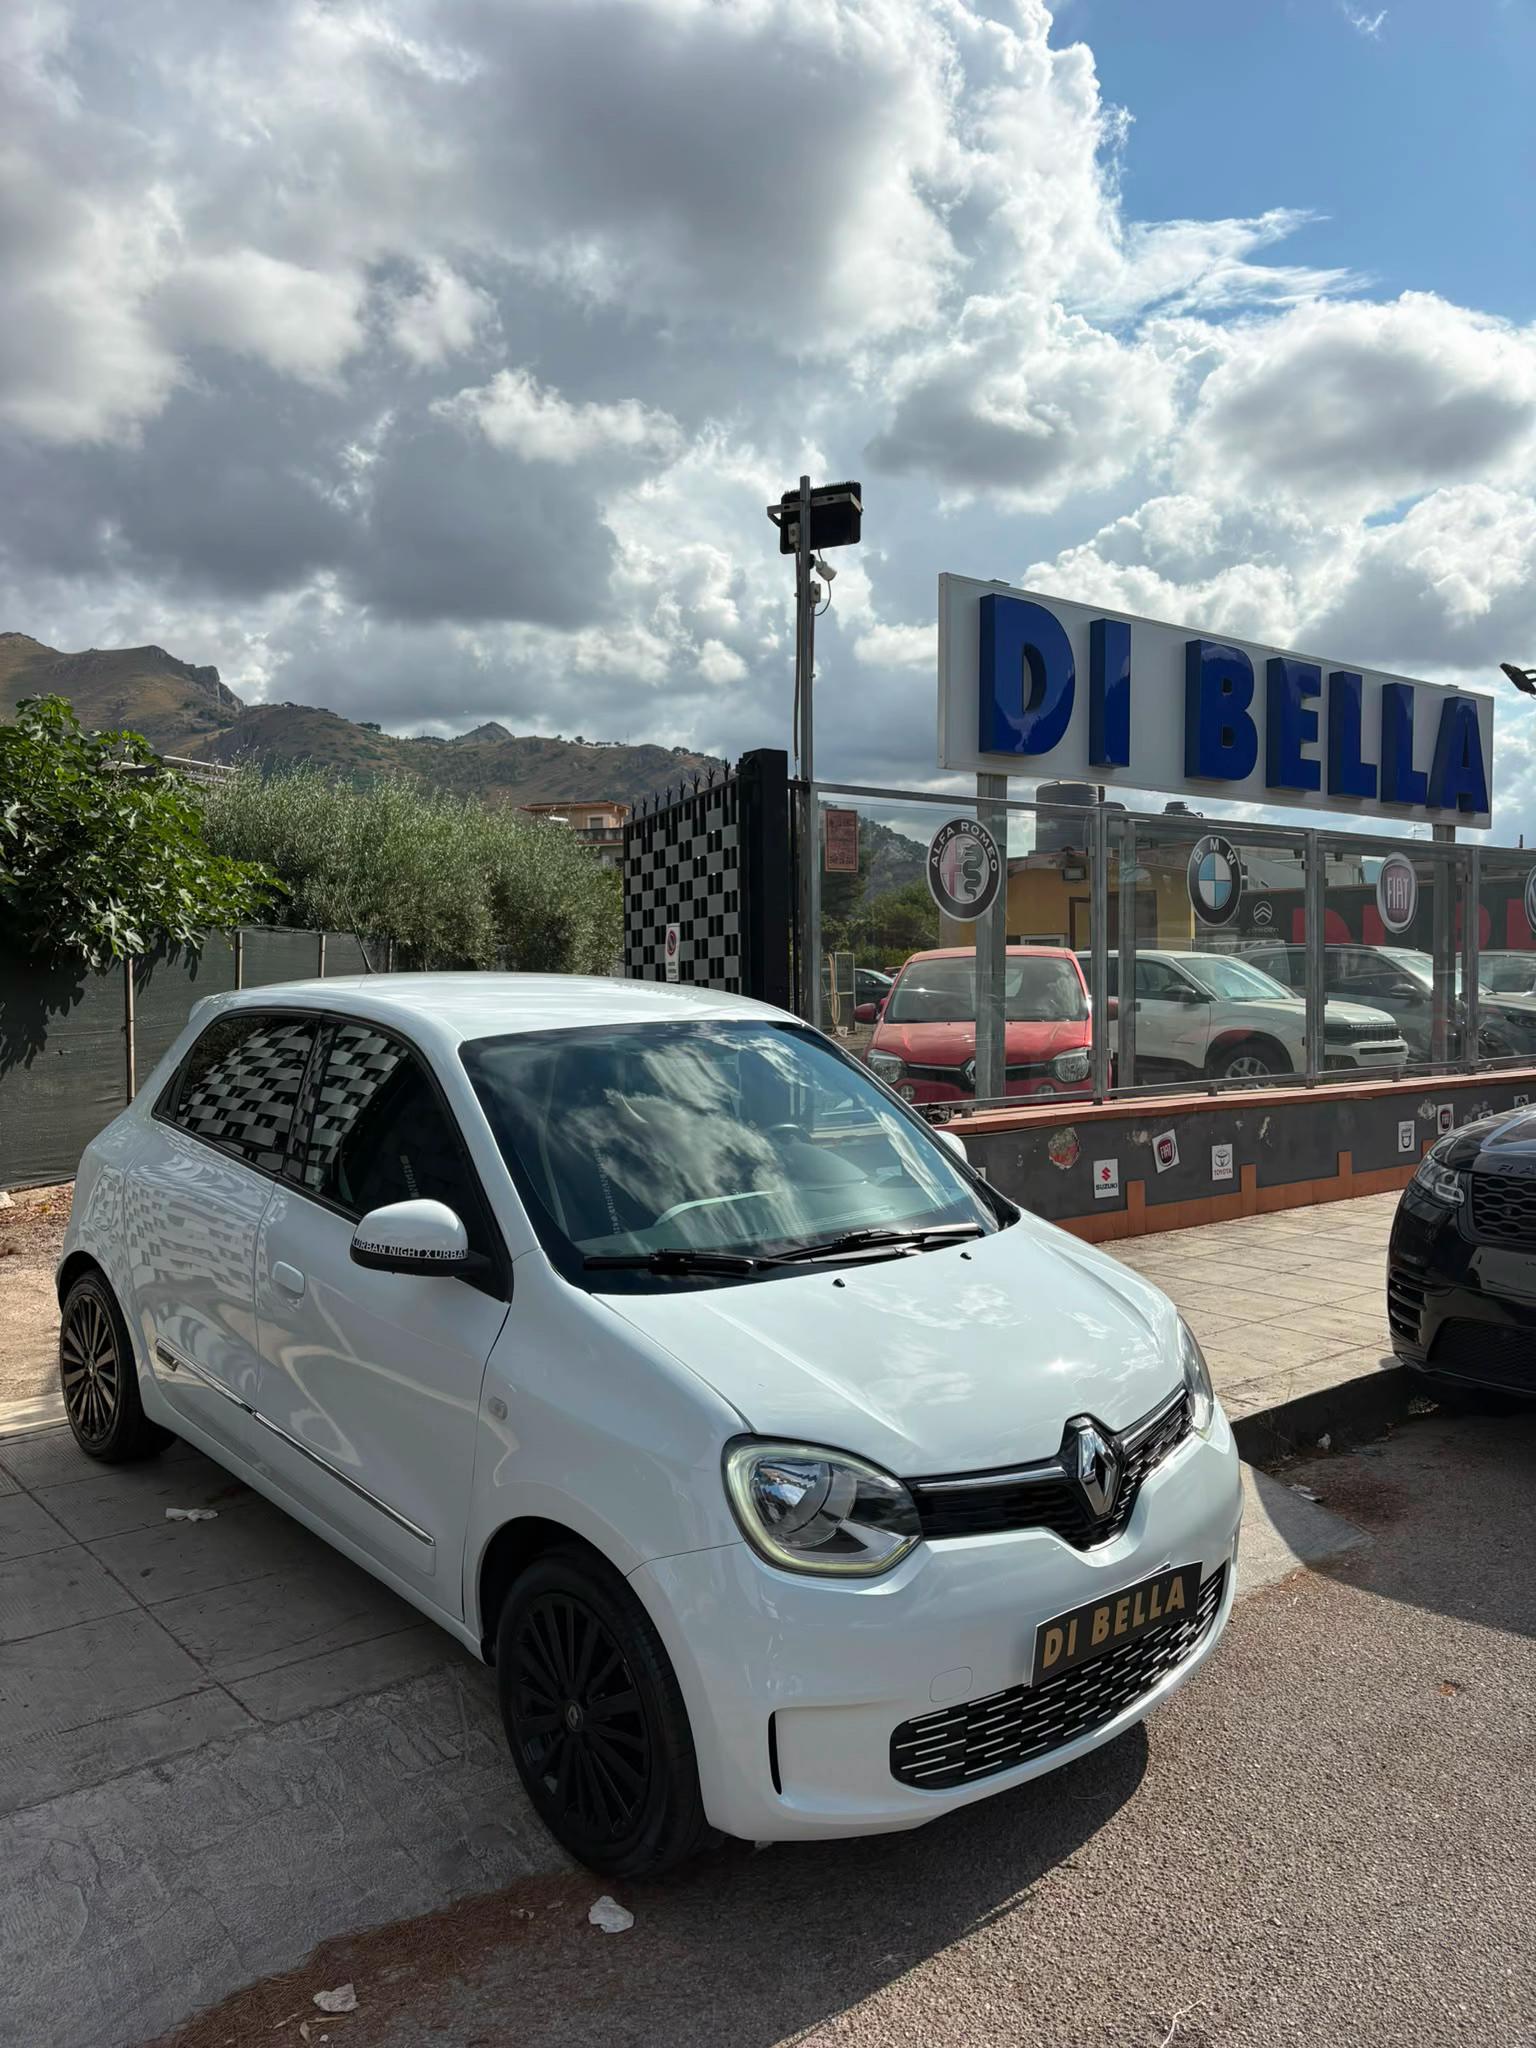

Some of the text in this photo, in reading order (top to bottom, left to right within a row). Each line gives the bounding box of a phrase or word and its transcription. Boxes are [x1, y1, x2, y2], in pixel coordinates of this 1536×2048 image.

[979, 594, 1489, 814] DI BELLA
[931, 821, 998, 872] ALFA ROMEO
[1193, 838, 1236, 865] BMW
[1387, 877, 1409, 910] FIAT
[1160, 1144, 1172, 1160] FIAT
[389, 1245, 421, 1257] NIGHT
[1042, 1575, 1186, 1669] DI BELLA
